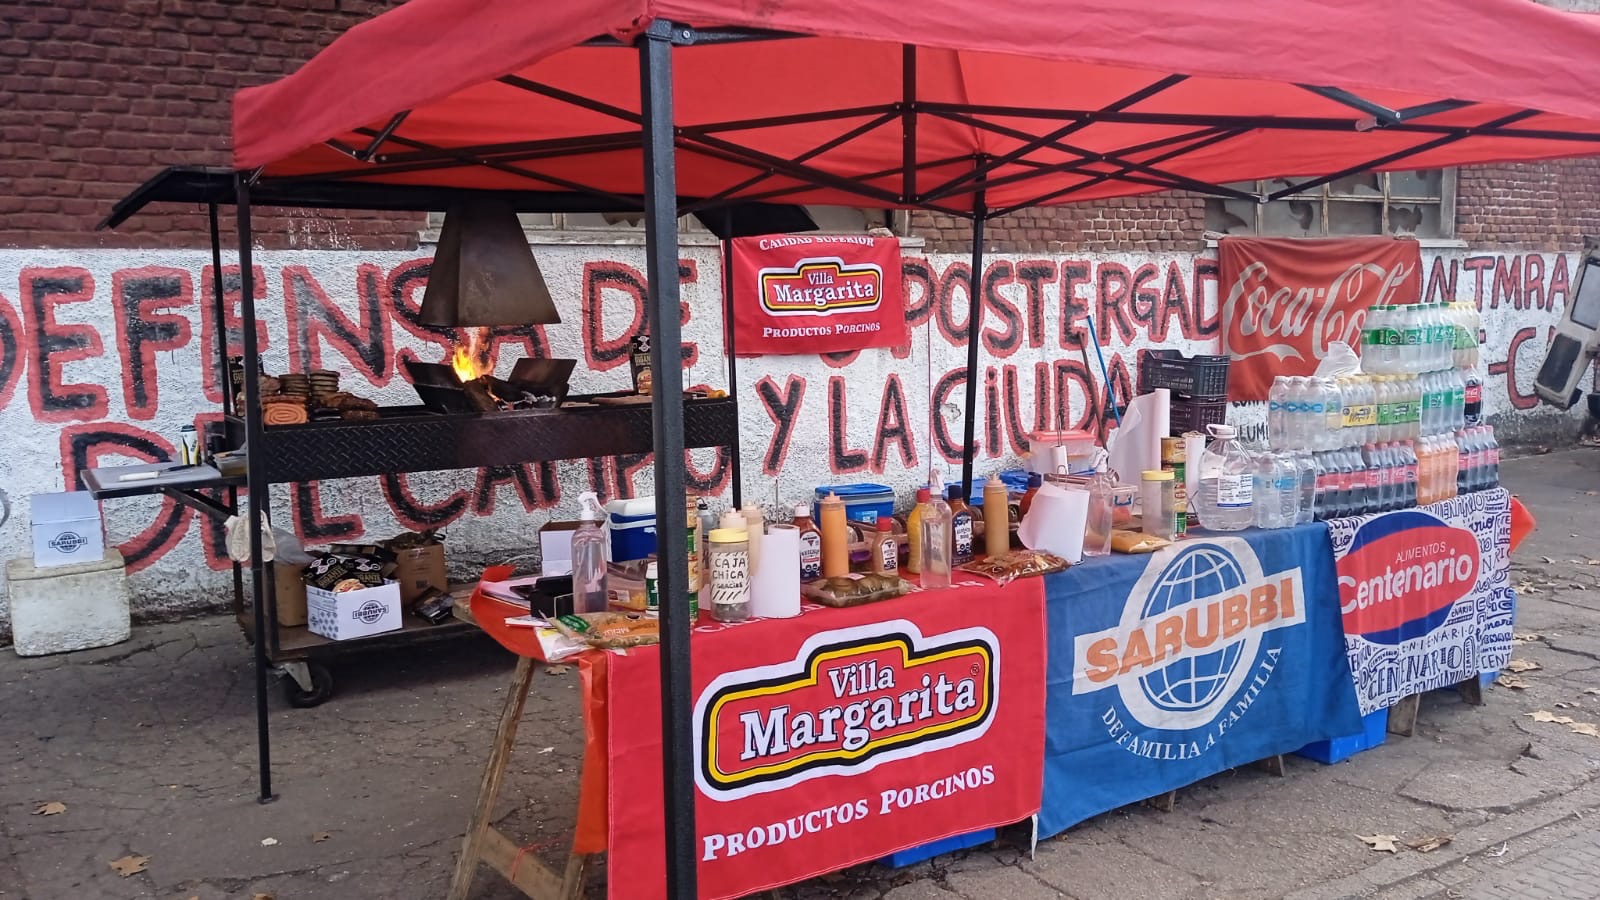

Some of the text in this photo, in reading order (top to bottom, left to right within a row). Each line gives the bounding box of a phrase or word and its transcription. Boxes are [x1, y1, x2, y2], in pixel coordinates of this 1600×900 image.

[773, 280, 875, 306] Margarita
[807, 271, 834, 286] Villa
[762, 321, 881, 338] PRODUCTOS PORCINOS
[1222, 261, 1415, 361] Coca-Col
[756, 373, 806, 477] Y
[827, 373, 918, 477] LA
[714, 557, 746, 569] CAJA
[1338, 550, 1474, 614] Centenario
[1395, 541, 1447, 564] ALIMENTOS
[1084, 577, 1297, 684] SARUBBI
[828, 659, 896, 698] Villa
[1205, 733, 1217, 750] A
[1218, 646, 1283, 738] FAMILIA
[739, 672, 977, 761] Margarita
[702, 764, 996, 862] PRODUCTOS PORCINOS
